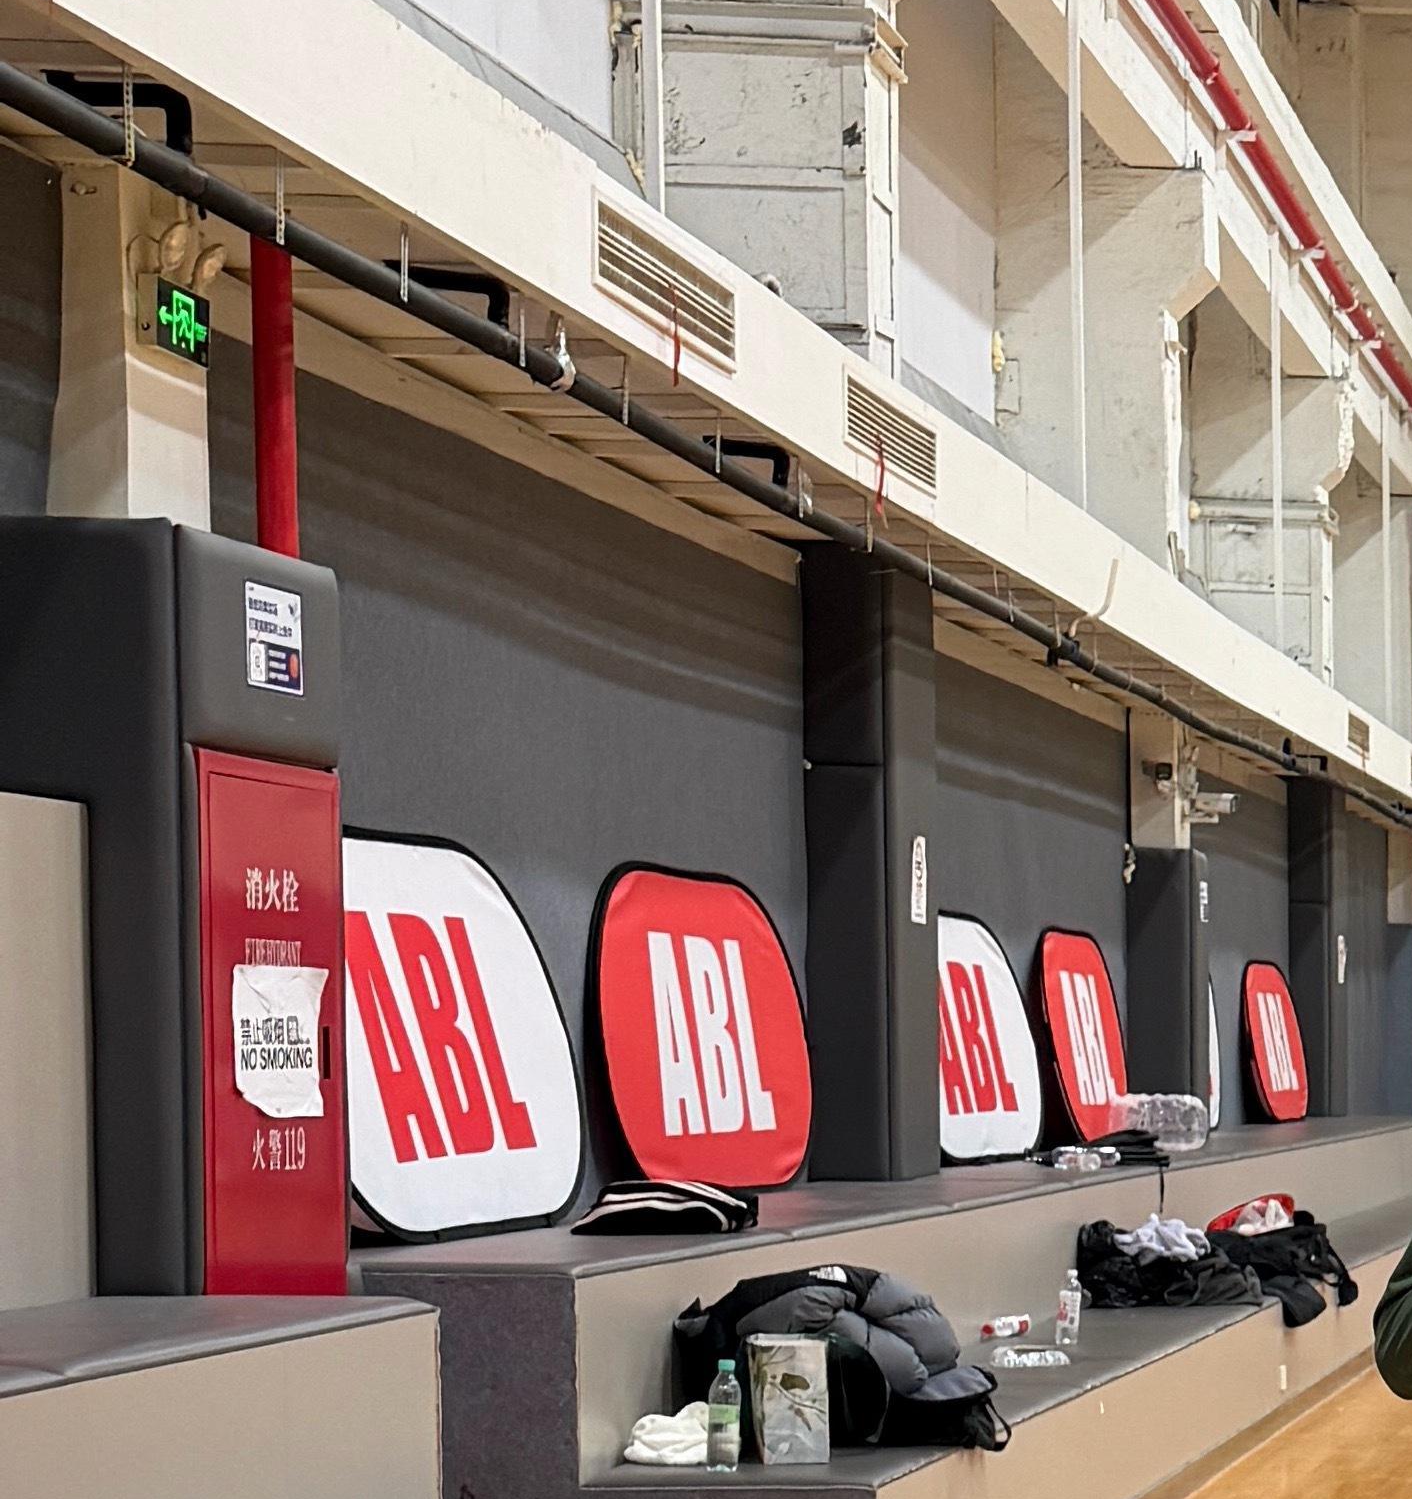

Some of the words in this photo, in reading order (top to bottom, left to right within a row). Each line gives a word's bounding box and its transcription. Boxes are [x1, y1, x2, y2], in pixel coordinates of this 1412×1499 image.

[245, 866, 300, 913] 消火栓
[240, 1048, 257, 1071] NO
[260, 1046, 313, 1070] SMOKING
[345, 911, 537, 1163] ABL
[647, 931, 776, 1136] ABL
[938, 961, 1019, 1115] ABL
[1059, 970, 1118, 1107] ABL
[1256, 991, 1300, 1093] ABL
